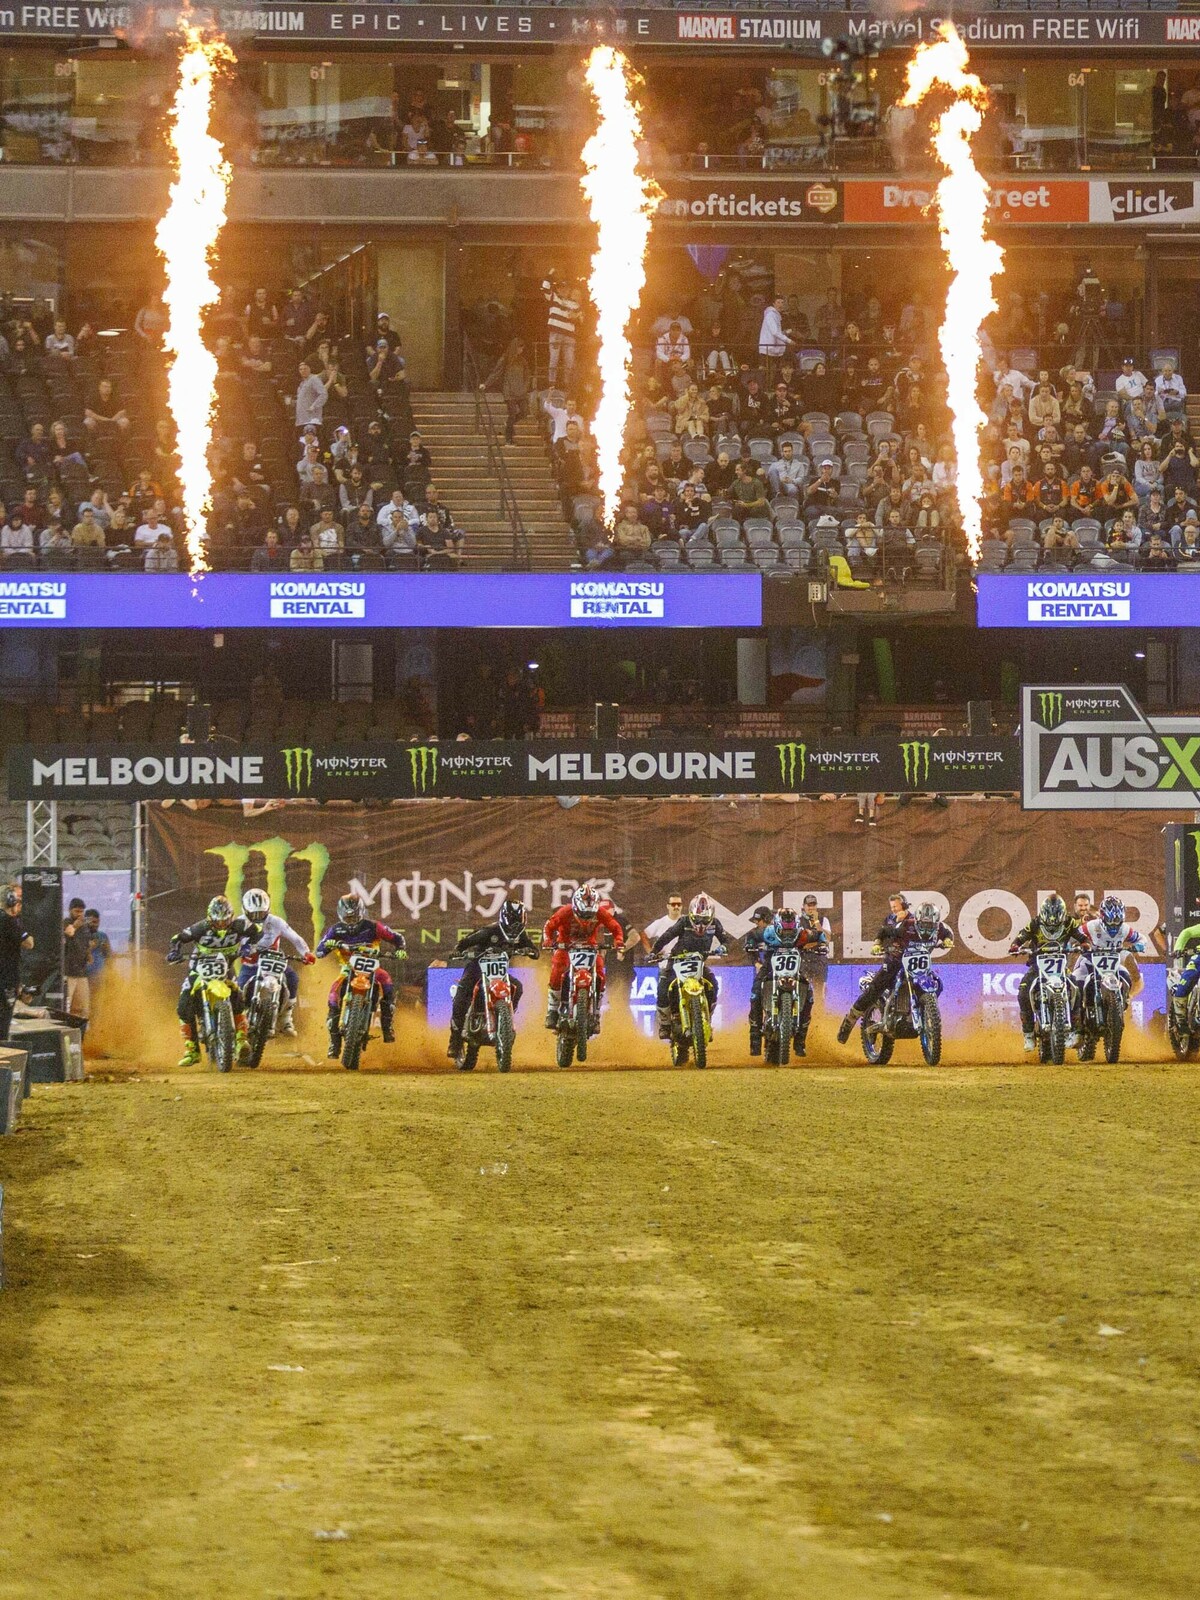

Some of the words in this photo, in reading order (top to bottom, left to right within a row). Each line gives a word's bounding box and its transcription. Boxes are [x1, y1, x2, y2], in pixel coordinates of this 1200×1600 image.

[21, 6, 81, 27] FREE
[331, 14, 401, 31] EPIC
[441, 15, 532, 33] LIVES
[678, 17, 735, 39] MARVEL
[740, 19, 821, 39] STADIUM
[848, 17, 923, 39] Marvel
[1032, 20, 1090, 40] FREE
[1096, 18, 1140, 40] Wifi
[310, 65, 326, 80] 61
[1067, 72, 1085, 87] 64
[1110, 188, 1176, 214] click
[270, 582, 366, 597] KOMATSU
[570, 582, 664, 597] KOMATSU
[1027, 582, 1131, 598] KOMATSU
[0, 601, 53, 615] ENTAL
[283, 601, 353, 615] RENTAL
[582, 601, 652, 615] RENTAL
[1041, 603, 1117, 618] RENTAL
[1065, 697, 1121, 711] MONSTER
[316, 754, 388, 770] MONSTER
[441, 753, 513, 769] MONSTER
[809, 751, 880, 765] MONSTER
[933, 750, 1004, 764] MONSTER
[32, 756, 264, 786] MELBOURNE
[528, 751, 756, 781] MELBOURNE
[347, 870, 623, 920] MONSTER
[199, 932, 239, 948] FXR
[259, 960, 286, 974] 56
[353, 957, 376, 971] 62
[571, 952, 594, 968] J21
[774, 955, 797, 972] 36
[907, 955, 929, 971] 86
[1043, 958, 1066, 974] 21
[1096, 957, 1119, 971] 47
[201, 962, 226, 977] 33
[679, 961, 699, 975] 3
